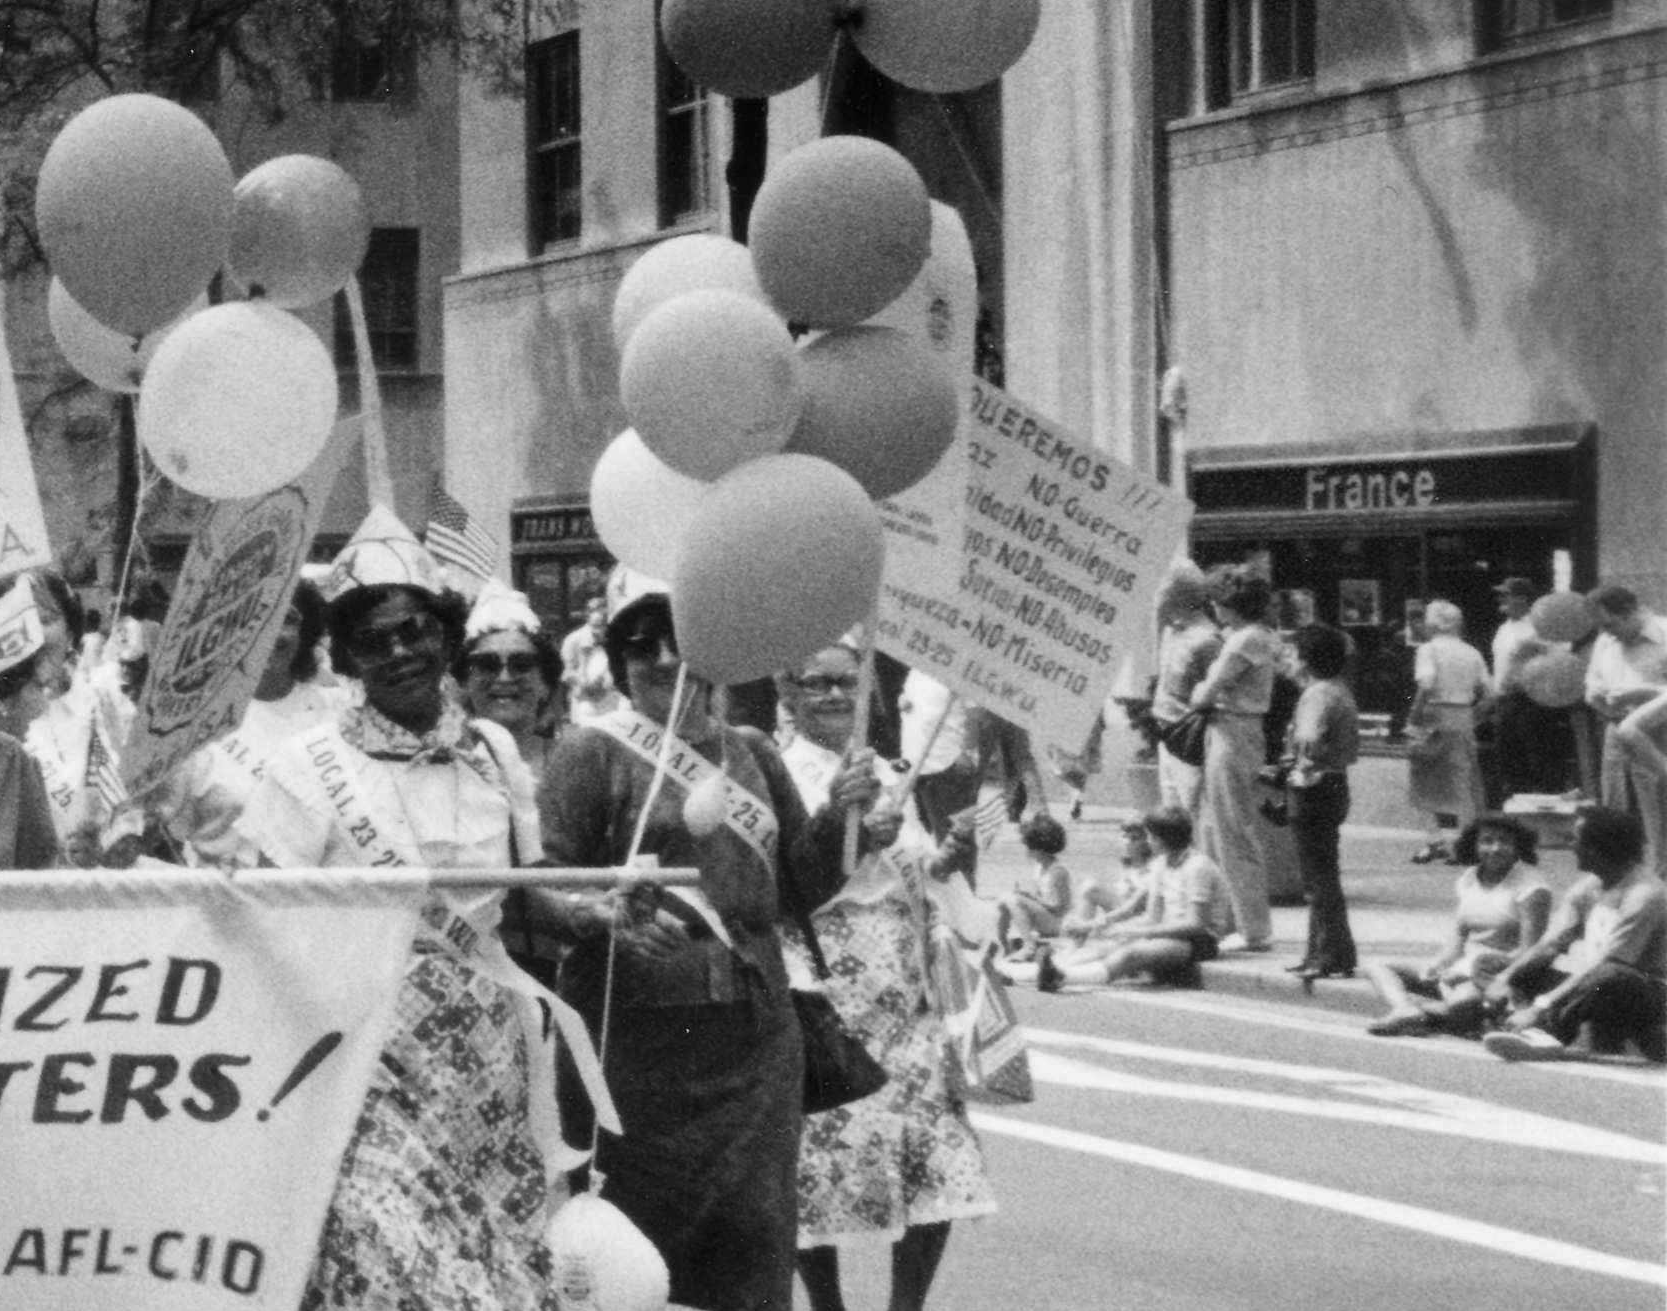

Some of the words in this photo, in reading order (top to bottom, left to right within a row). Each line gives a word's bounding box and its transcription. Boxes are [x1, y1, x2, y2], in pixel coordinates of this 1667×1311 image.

[968, 441, 998, 469] az
[1305, 468, 1436, 511] France
[305, 736, 356, 817] LOCAL
[2, 1227, 267, 1297] AFL-CIO
